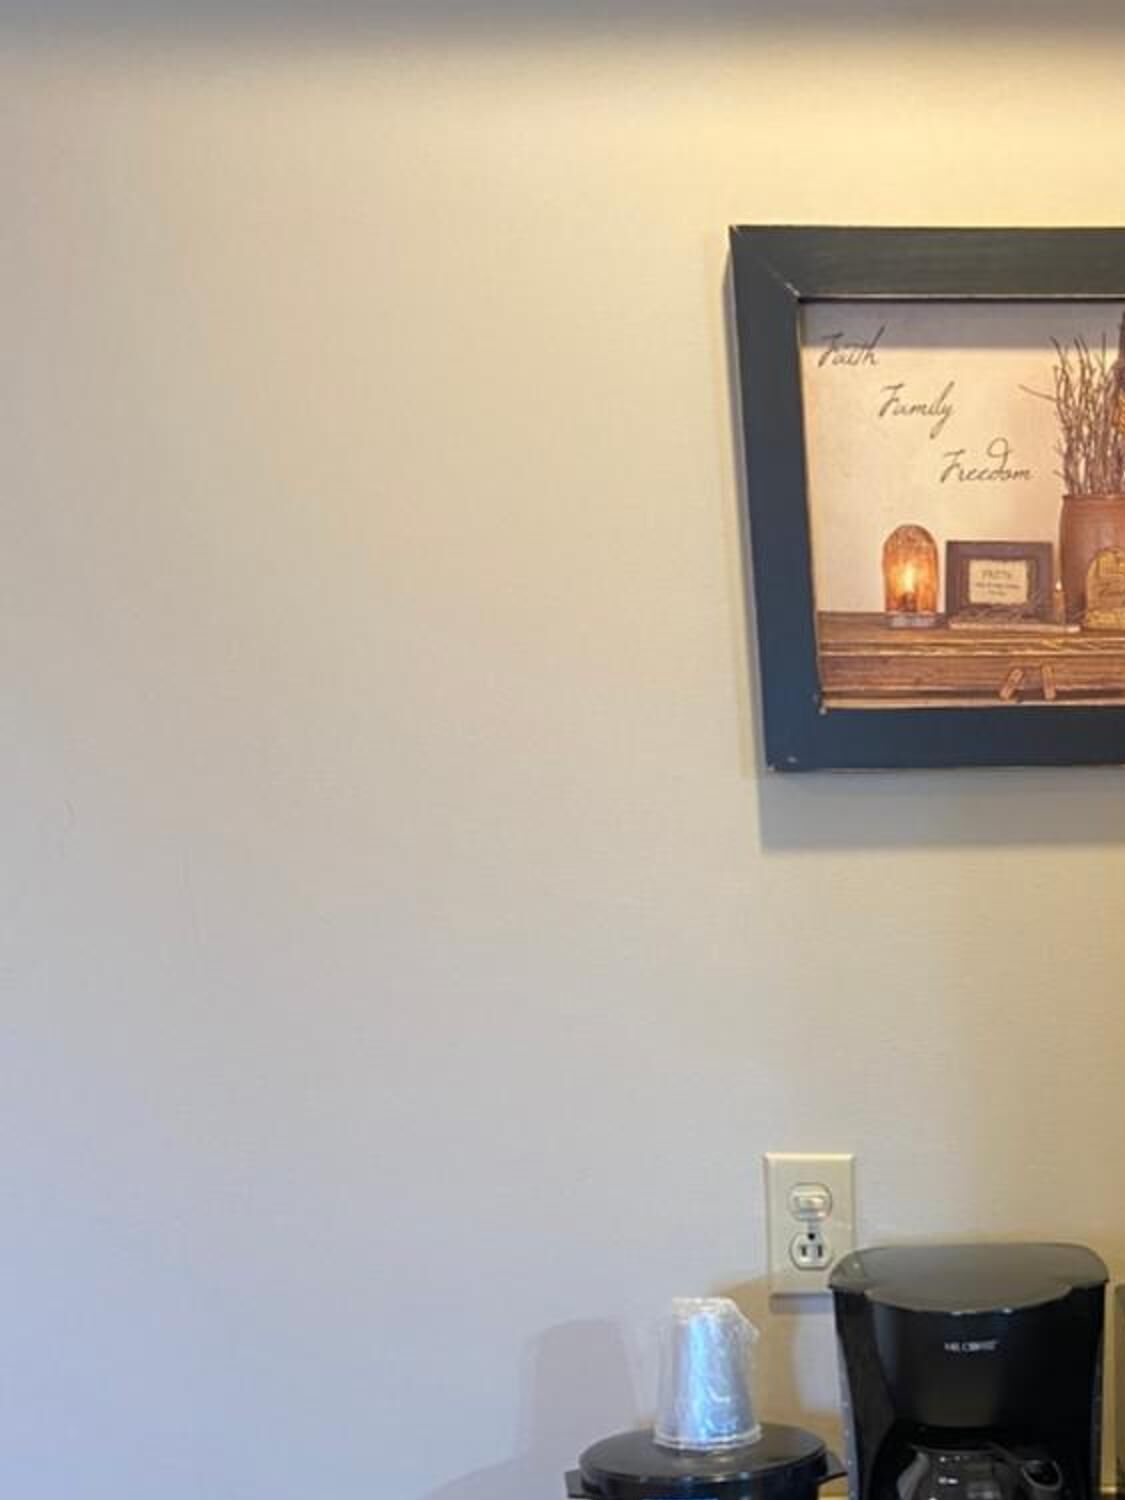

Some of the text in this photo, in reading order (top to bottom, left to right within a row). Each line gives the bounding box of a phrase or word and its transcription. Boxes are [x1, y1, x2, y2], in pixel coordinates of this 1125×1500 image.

[818, 325, 885, 367] Faith
[879, 381, 955, 439] Family
[940, 437, 1032, 483] Freedom
